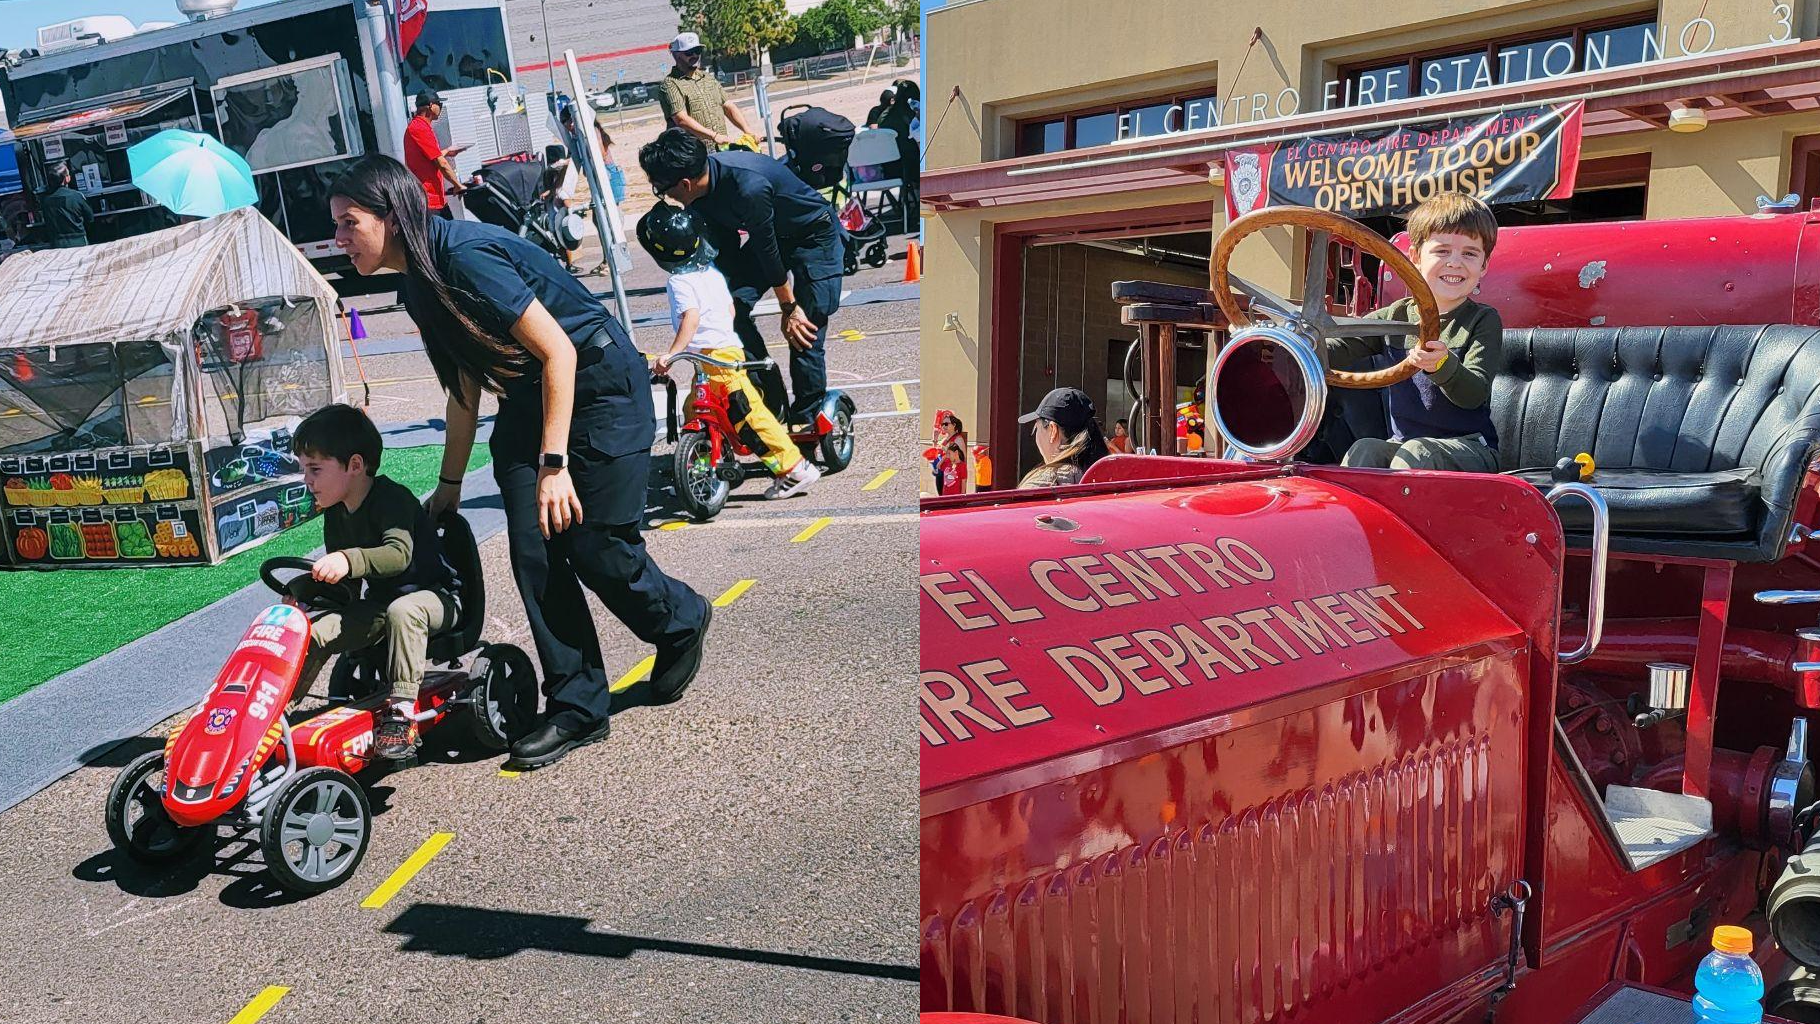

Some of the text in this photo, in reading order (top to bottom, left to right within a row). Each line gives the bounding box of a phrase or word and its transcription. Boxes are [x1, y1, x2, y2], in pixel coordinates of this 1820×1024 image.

[1164, 87, 1301, 134] CENTRO
[1323, 68, 1402, 111] FIRE
[1425, 34, 1611, 97] STATION
[1769, 3, 1792, 44] 3
[1284, 147, 1420, 190] WELCOME
[1427, 144, 1466, 176] TO
[1470, 131, 1541, 168] OUR
[1287, 146, 1302, 161] EL
[1308, 139, 1372, 159] CENTRO
[1376, 133, 1412, 153] FIRE
[1315, 167, 1495, 212] OPEN HOUSE
[920, 537, 1276, 631] EL CENTRO
[249, 624, 286, 642] FIRE
[1045, 584, 1427, 707] DEPARTMENT
